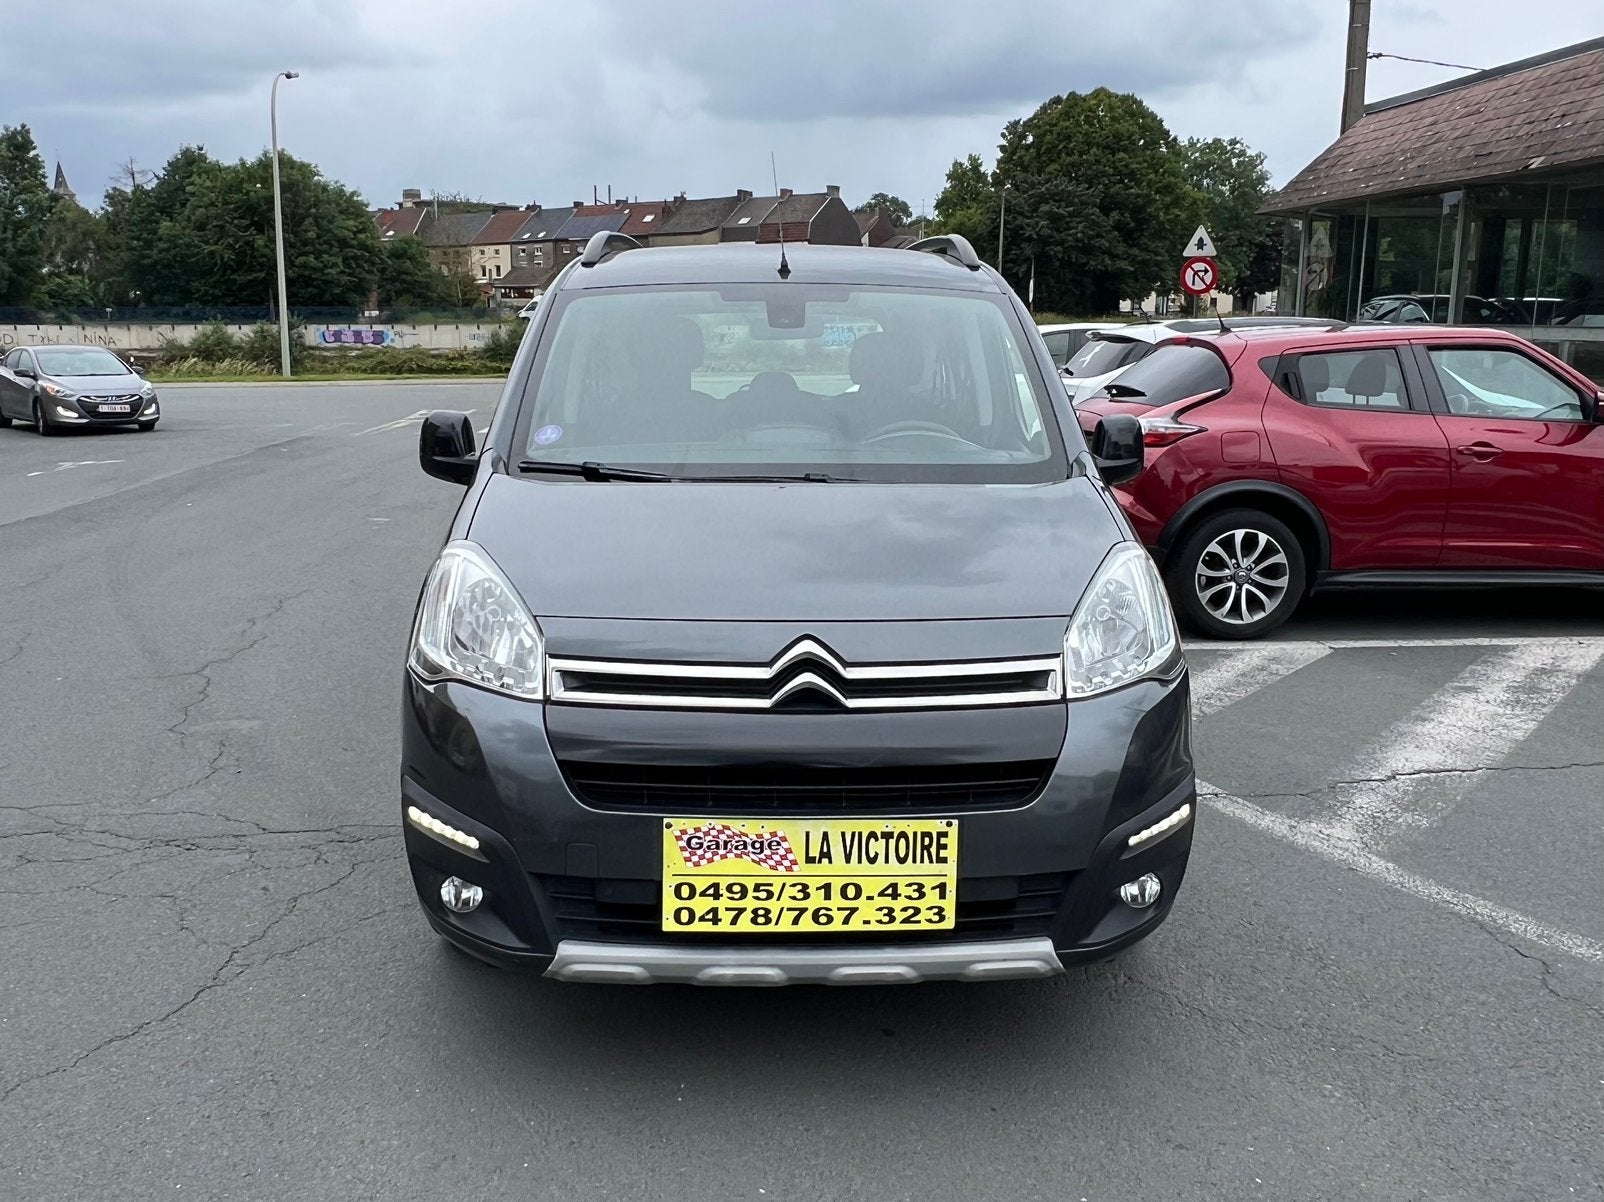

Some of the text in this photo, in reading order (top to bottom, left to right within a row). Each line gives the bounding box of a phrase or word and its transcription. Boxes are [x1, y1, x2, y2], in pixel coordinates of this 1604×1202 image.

[684, 830, 950, 865] Garage LA VICTOIRE
[672, 881, 948, 902] 0495/310.431
[672, 906, 947, 926] 0478/767.323
